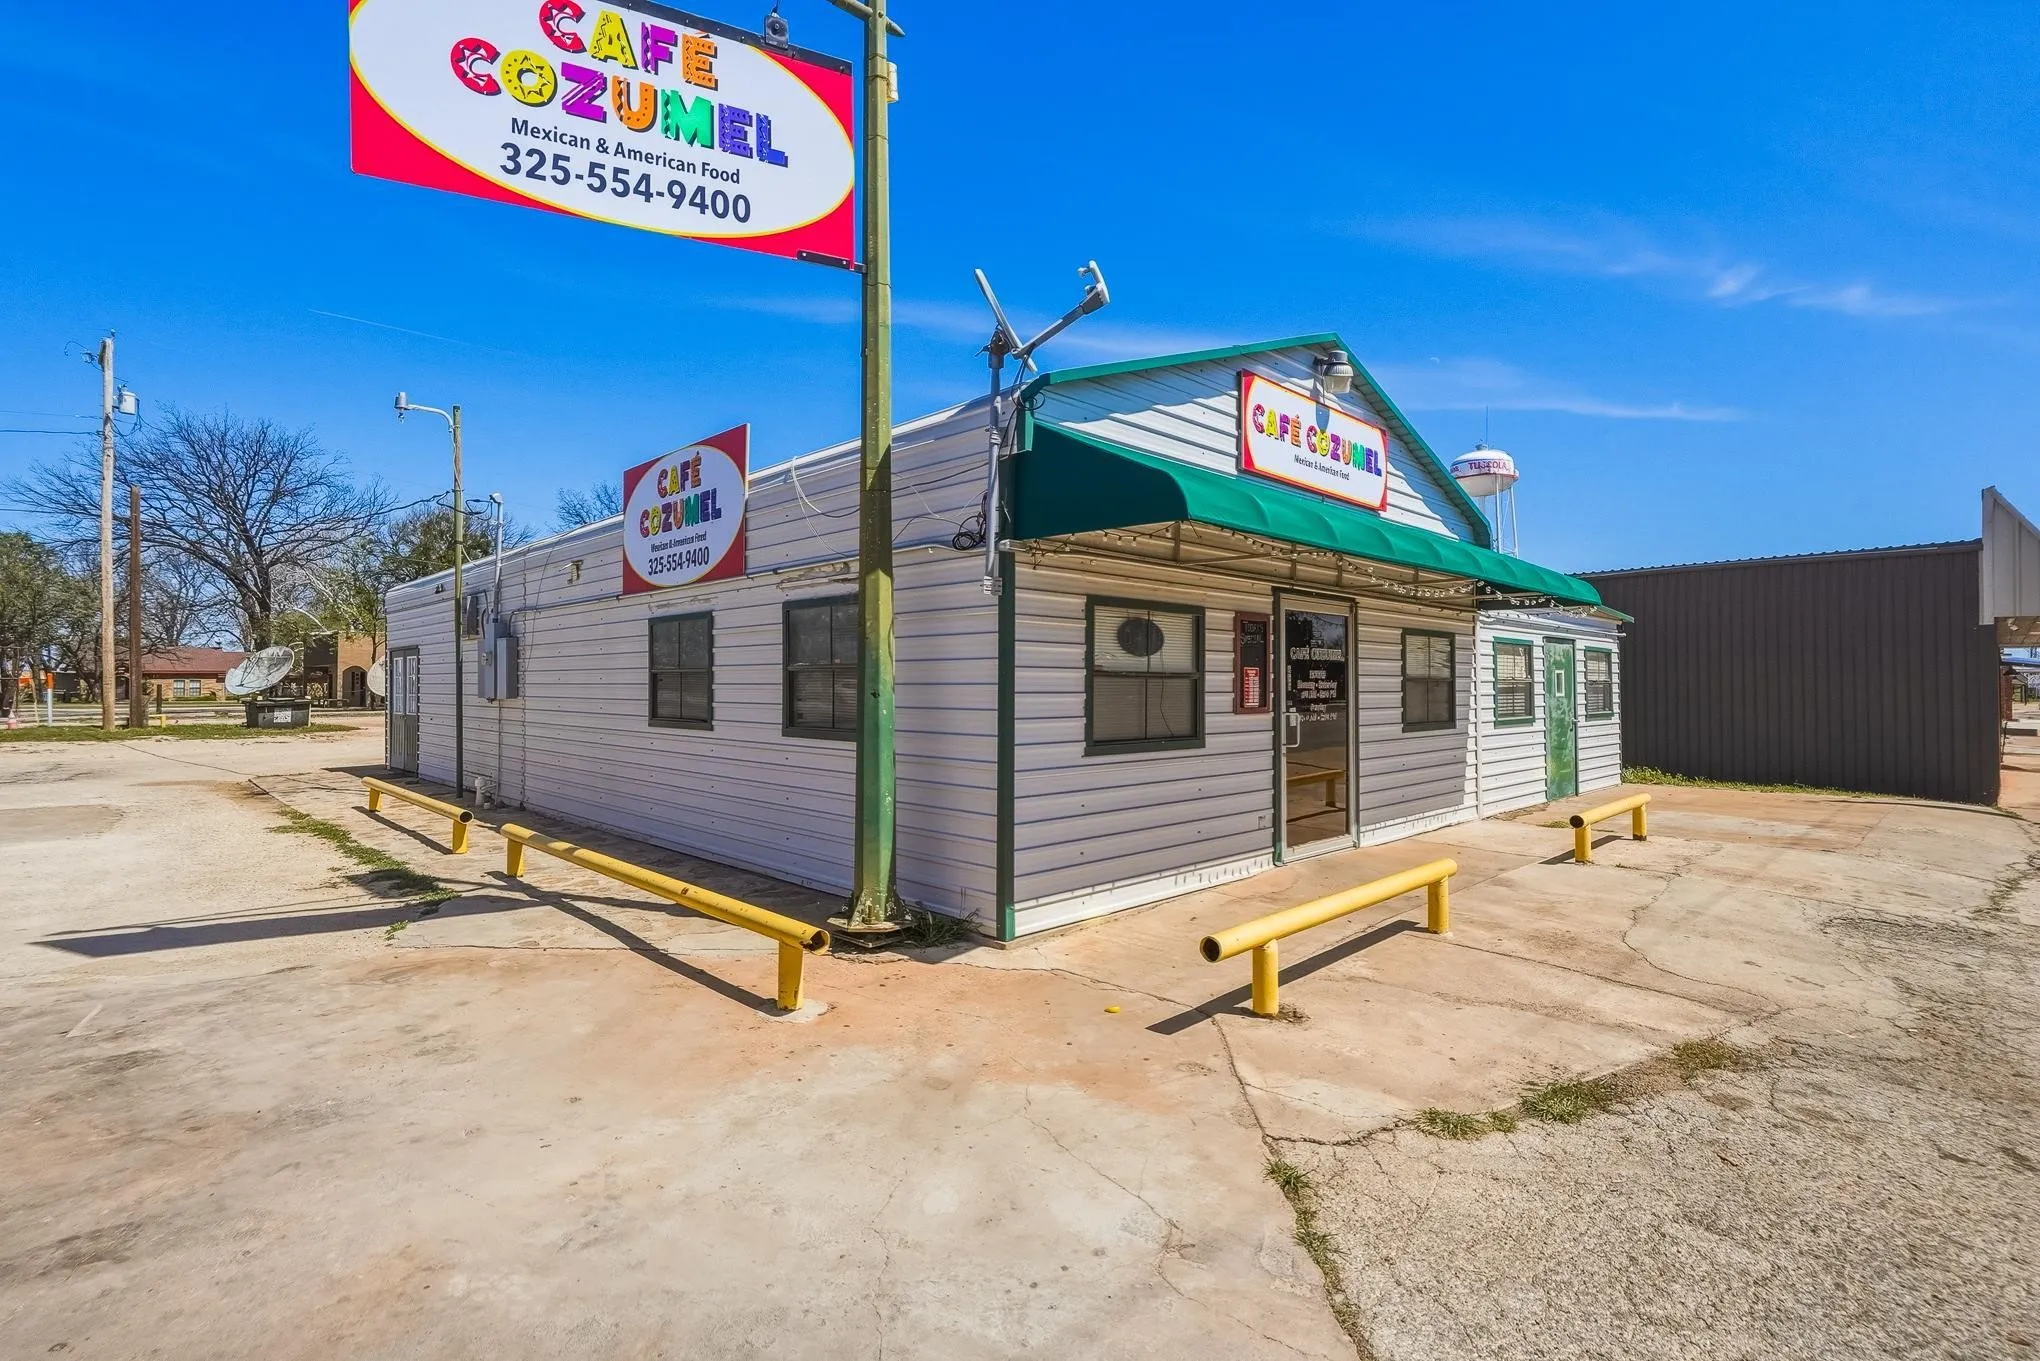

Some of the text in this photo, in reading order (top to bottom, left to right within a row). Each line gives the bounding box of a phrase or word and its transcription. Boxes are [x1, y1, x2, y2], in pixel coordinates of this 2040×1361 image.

[539, 0, 719, 92] CAFÉ
[451, 37, 788, 168] COZUMEL
[511, 117, 741, 184] Mexican & American Food
[500, 142, 751, 223] 325-554-9400
[1252, 403, 1301, 448] CAFÉ
[1307, 425, 1382, 477] COZUMEL
[657, 451, 702, 498] CAFÉ
[640, 488, 722, 538] COZUMEL
[648, 546, 710, 576] 325-554-9400
